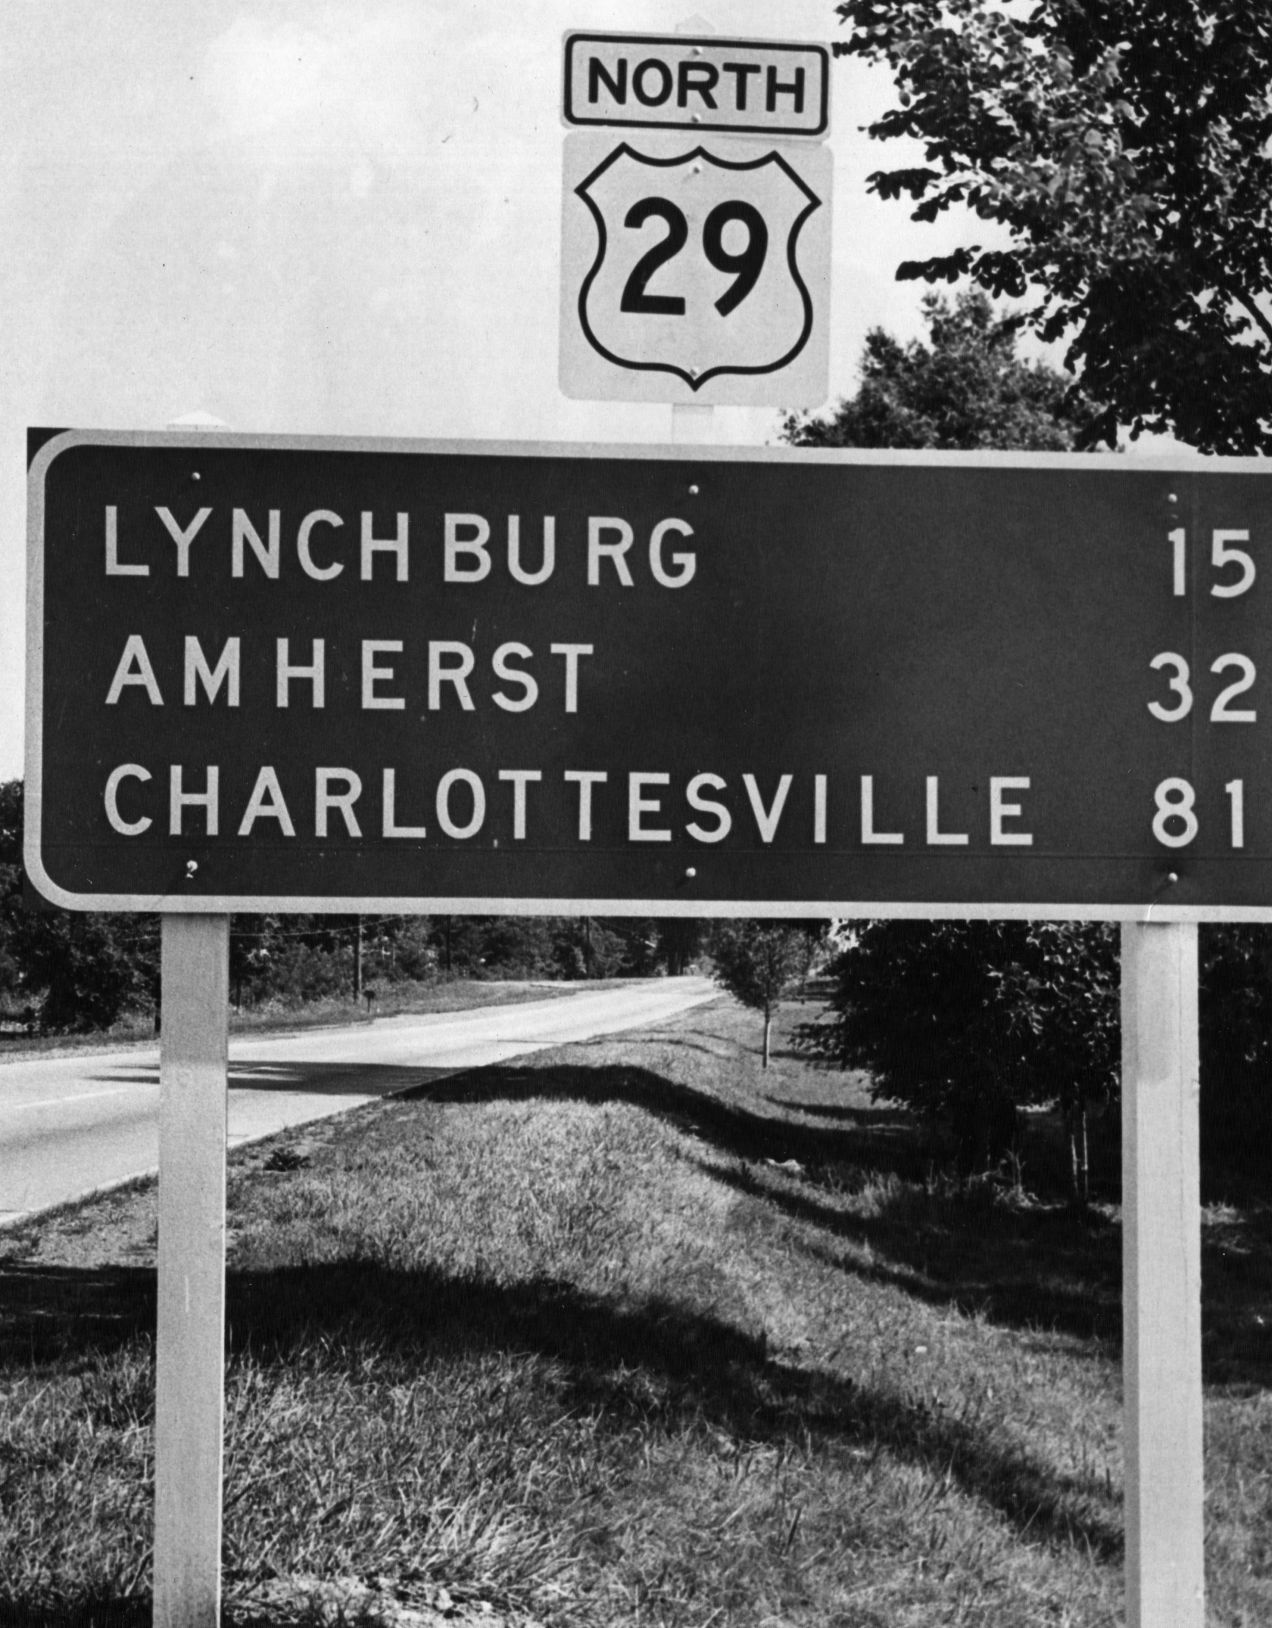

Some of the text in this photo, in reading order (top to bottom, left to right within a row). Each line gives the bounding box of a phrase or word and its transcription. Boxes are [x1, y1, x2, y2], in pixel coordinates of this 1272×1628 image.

[588, 56, 806, 114] NORTH
[620, 196, 769, 317] 29
[105, 505, 1256, 598] LYNCHBURG 15
[105, 634, 1257, 723] AMHERST 32
[104, 762, 1244, 848] CHARLOTTESVILLE 81
